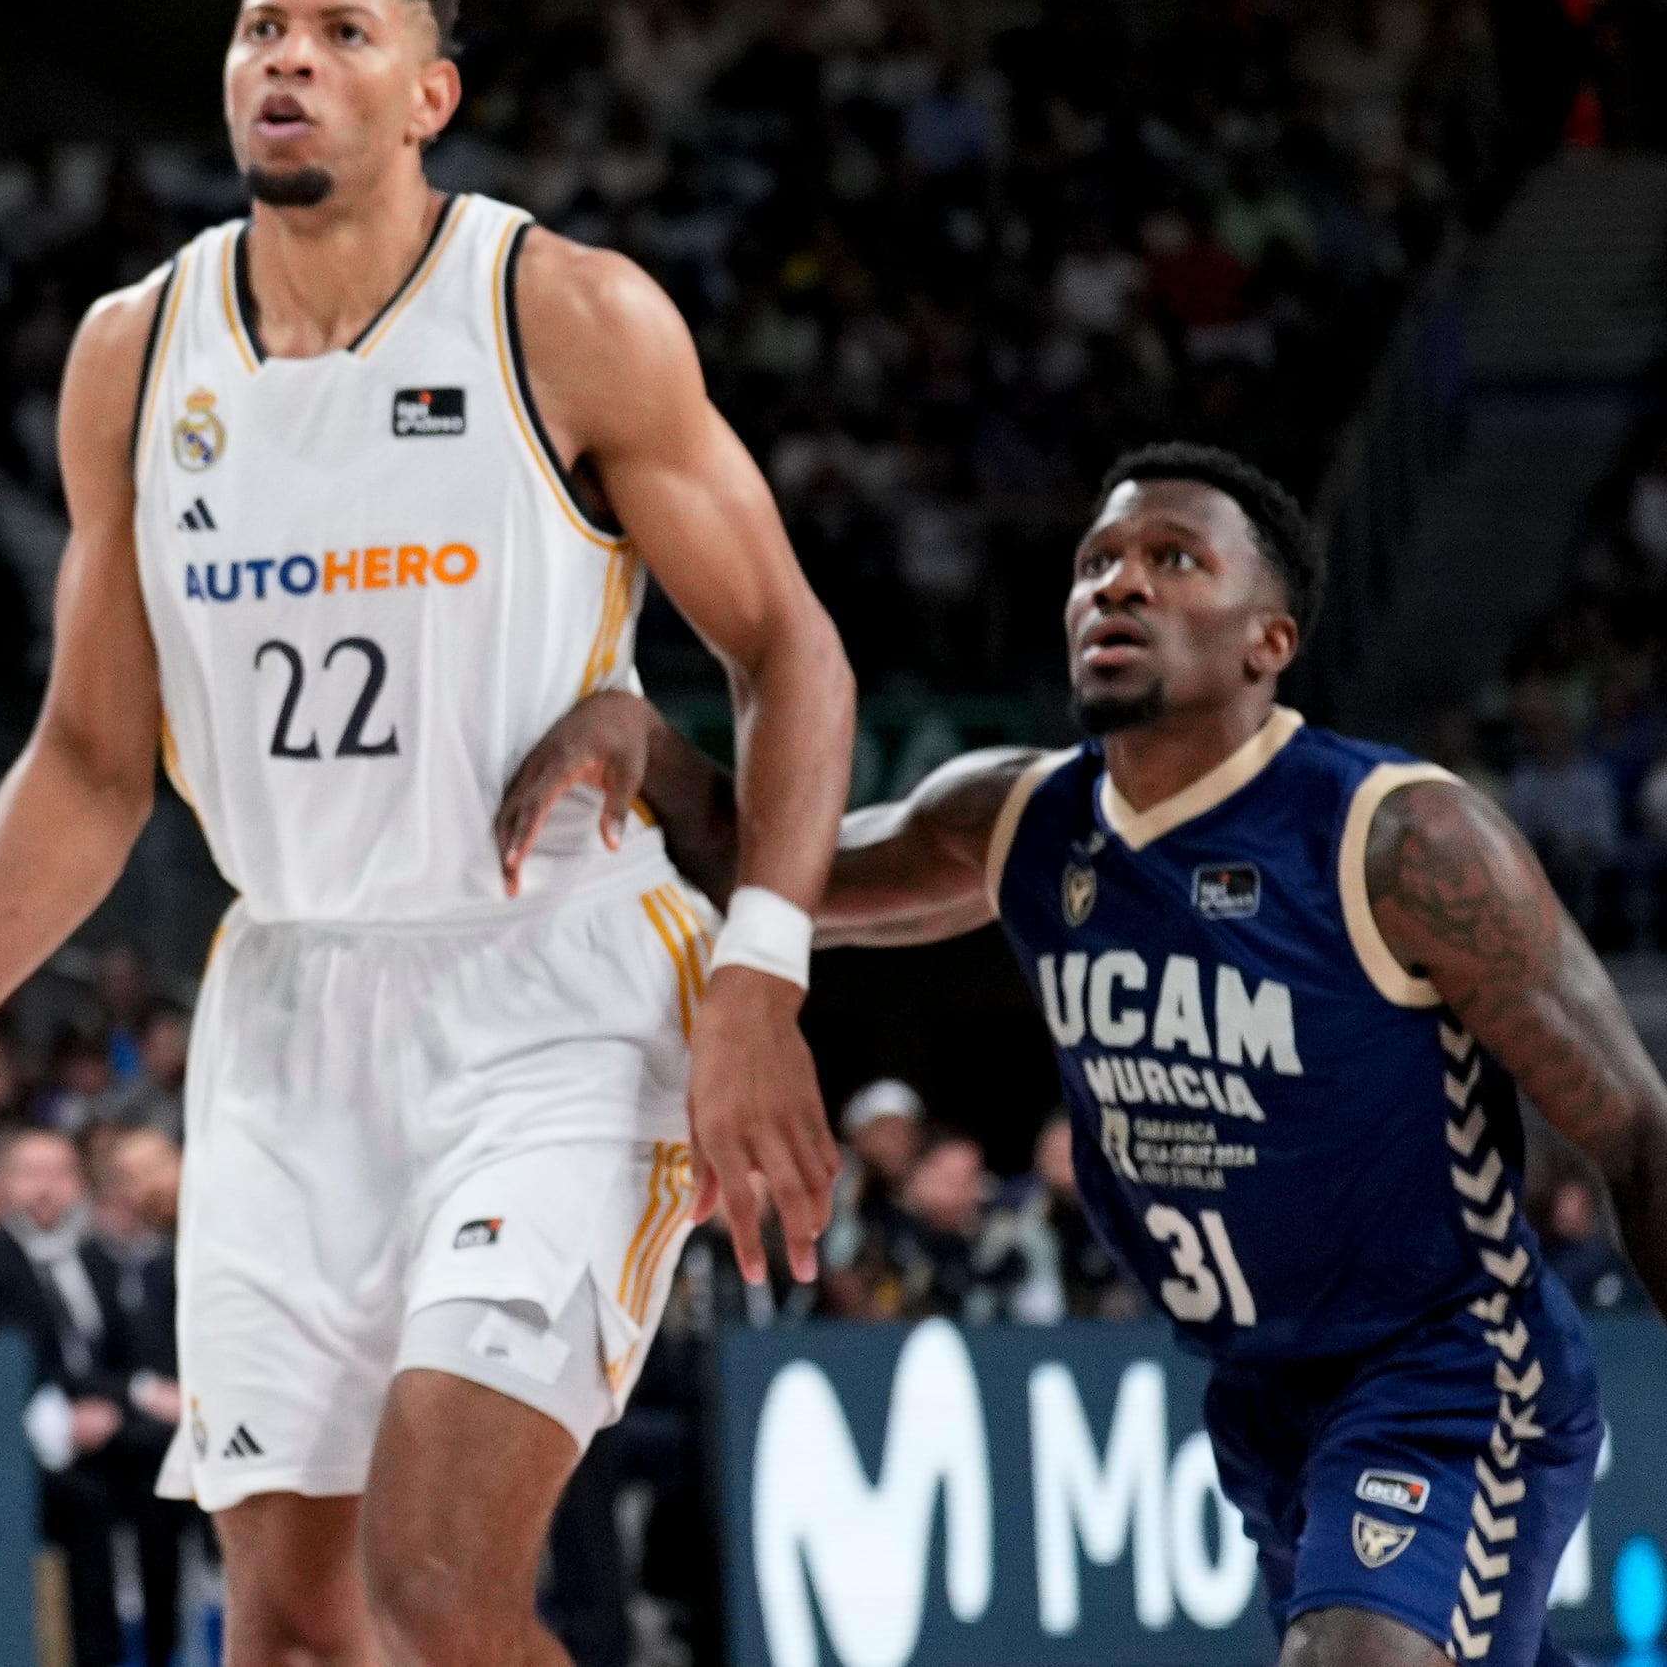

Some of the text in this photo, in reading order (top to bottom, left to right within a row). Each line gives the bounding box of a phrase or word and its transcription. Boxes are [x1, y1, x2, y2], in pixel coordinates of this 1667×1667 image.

[254, 636, 400, 761] 22
[1037, 948, 1304, 1076] UCAM
[1083, 1054, 1266, 1122] MURCIA
[1144, 1203, 1257, 1326] 31
